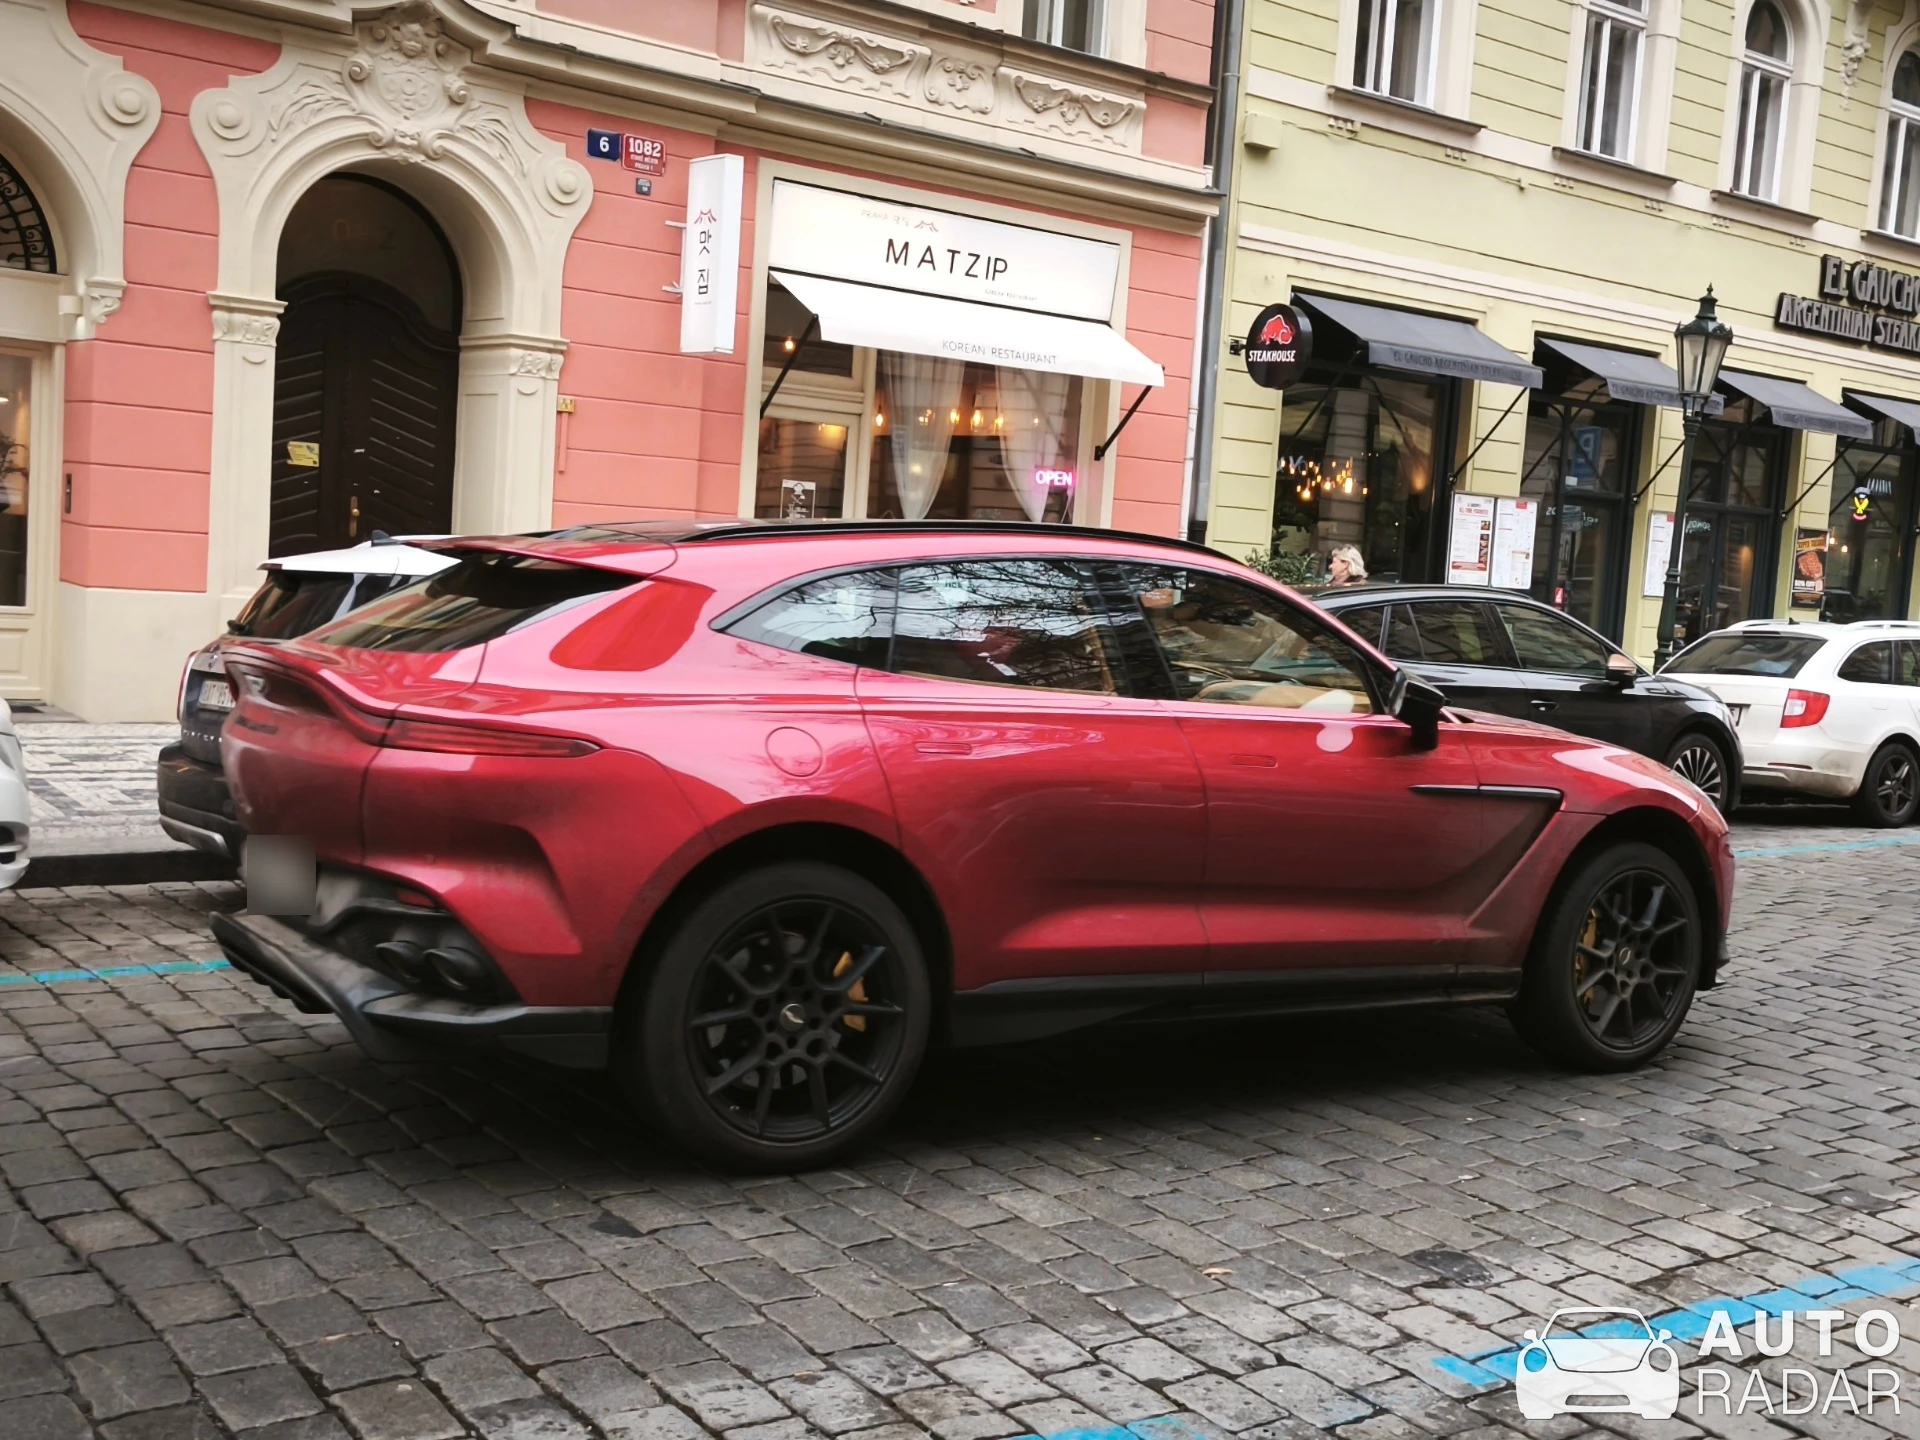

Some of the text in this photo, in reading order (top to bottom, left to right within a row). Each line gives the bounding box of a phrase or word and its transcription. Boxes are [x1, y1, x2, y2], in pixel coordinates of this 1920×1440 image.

[600, 136, 610, 152] 6
[629, 137, 662, 157] 1082
[885, 238, 1008, 281] MATZIP
[1823, 256, 1849, 297] EL
[1779, 295, 1875, 341] ARGENTINIAN
[942, 340, 1057, 365] KOREAN RESTAURANT
[1248, 350, 1296, 362] STEAKHOUSE
[1404, 351, 1433, 368] GAUCHO
[1035, 469, 1073, 486] OPEN
